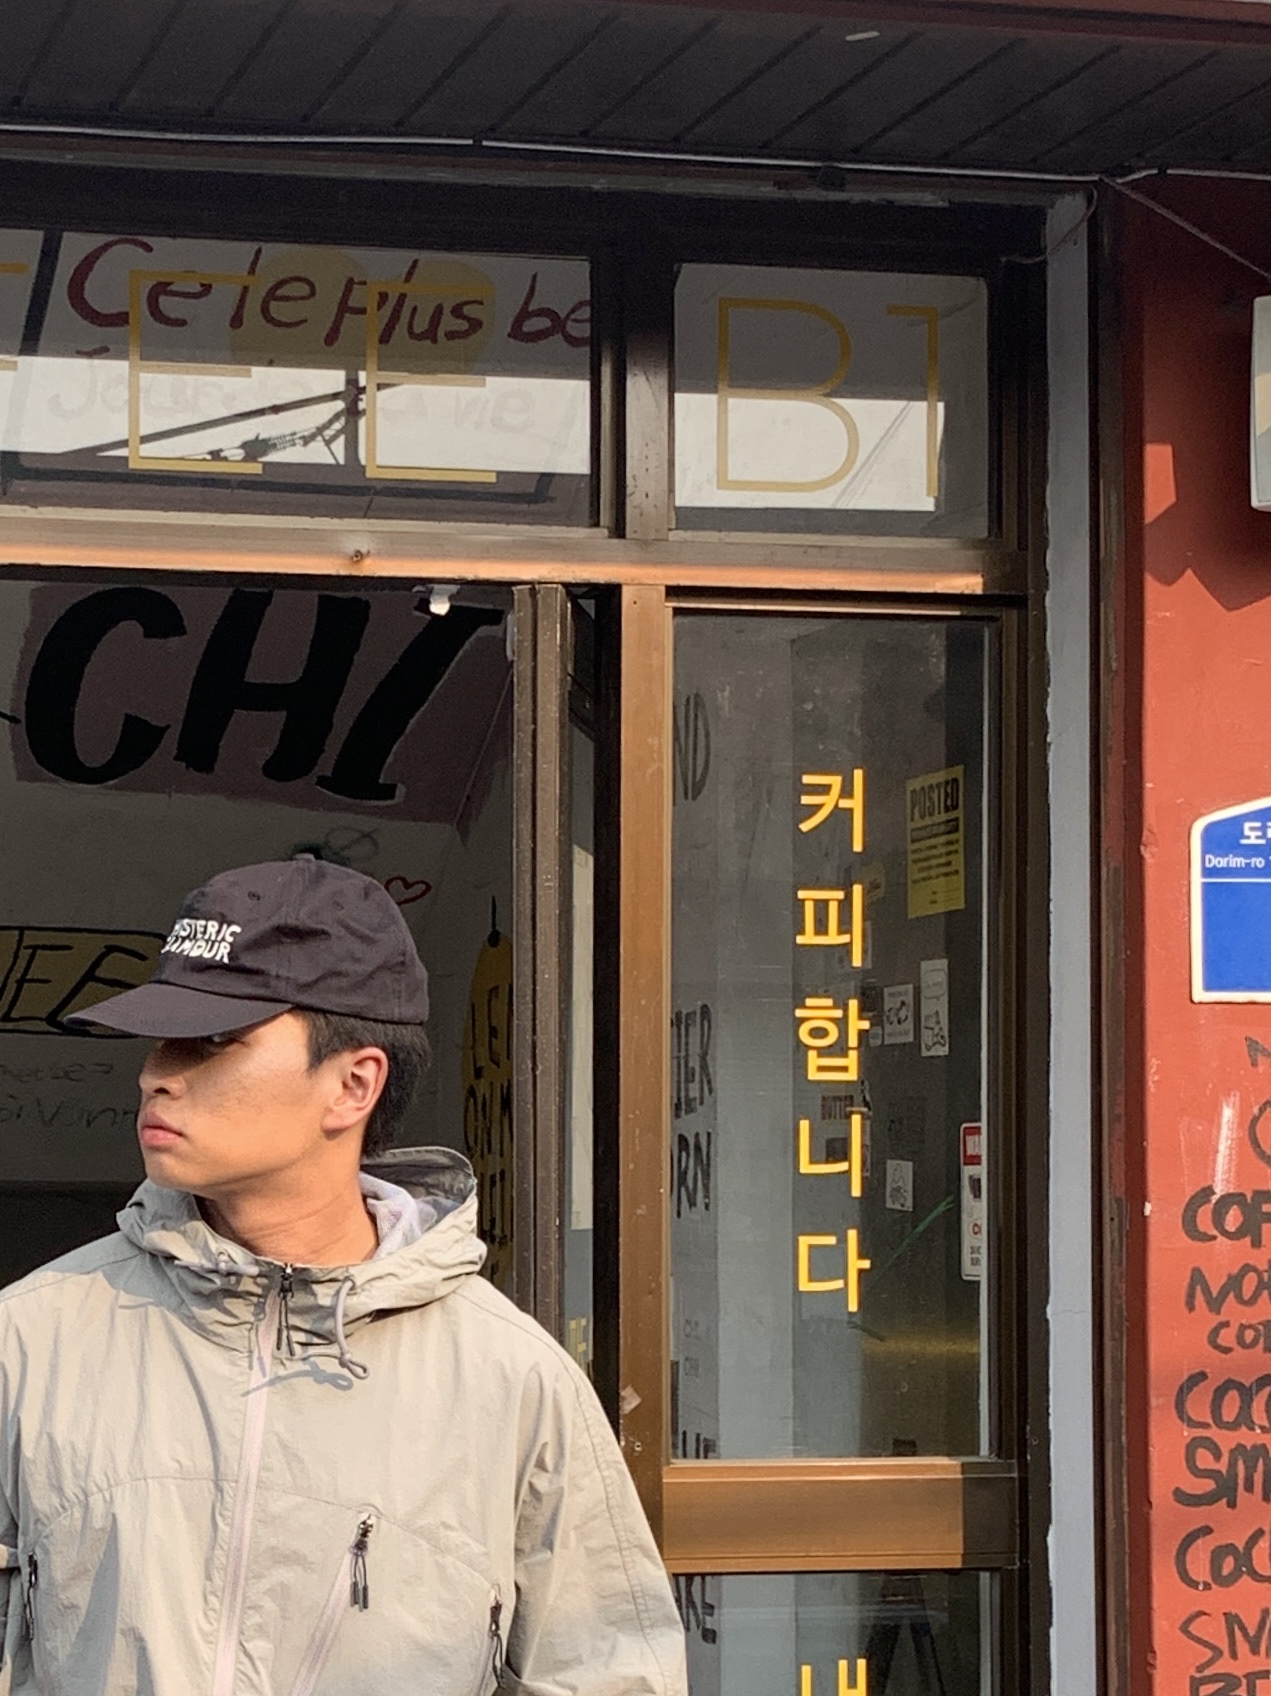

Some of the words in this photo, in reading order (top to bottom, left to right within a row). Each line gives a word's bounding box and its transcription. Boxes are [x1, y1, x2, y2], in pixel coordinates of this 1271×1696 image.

[716, 297, 939, 498] B1
[910, 777, 960, 822] POSTED
[1239, 821, 1271, 845] 도
[1204, 853, 1266, 869] Dorim-ro
[794, 768, 871, 1312] 커피합니다
